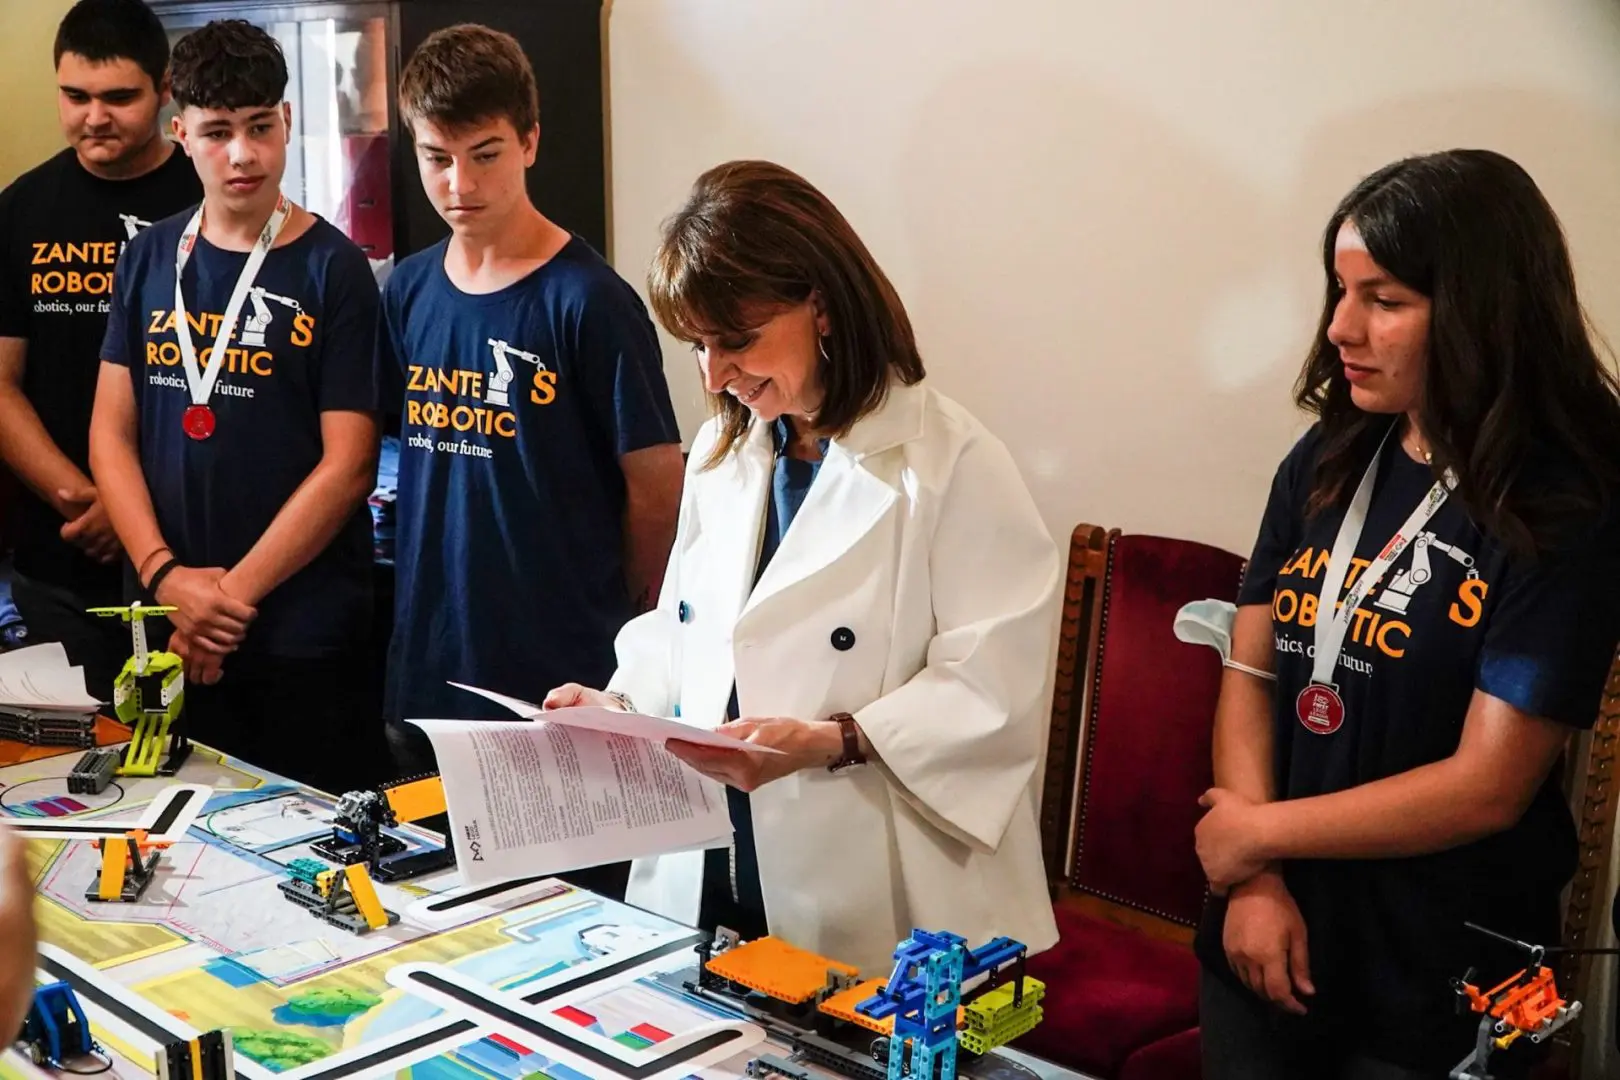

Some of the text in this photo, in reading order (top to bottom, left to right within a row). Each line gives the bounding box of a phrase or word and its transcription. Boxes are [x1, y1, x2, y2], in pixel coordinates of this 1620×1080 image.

[31, 242, 116, 265] ZANTE
[31, 271, 114, 295] ROBOT
[33, 299, 73, 316] obotics,
[75, 303, 96, 313] our
[290, 314, 316, 347] S
[146, 341, 273, 377] ROOTIC
[149, 370, 255, 398] robotics, future
[406, 364, 557, 405] ZANTE S
[407, 400, 516, 438] ROBOTIC
[437, 441, 459, 453] our
[459, 438, 493, 459] future
[1448, 578, 1489, 628] S
[1272, 590, 1412, 659] OBTIC
